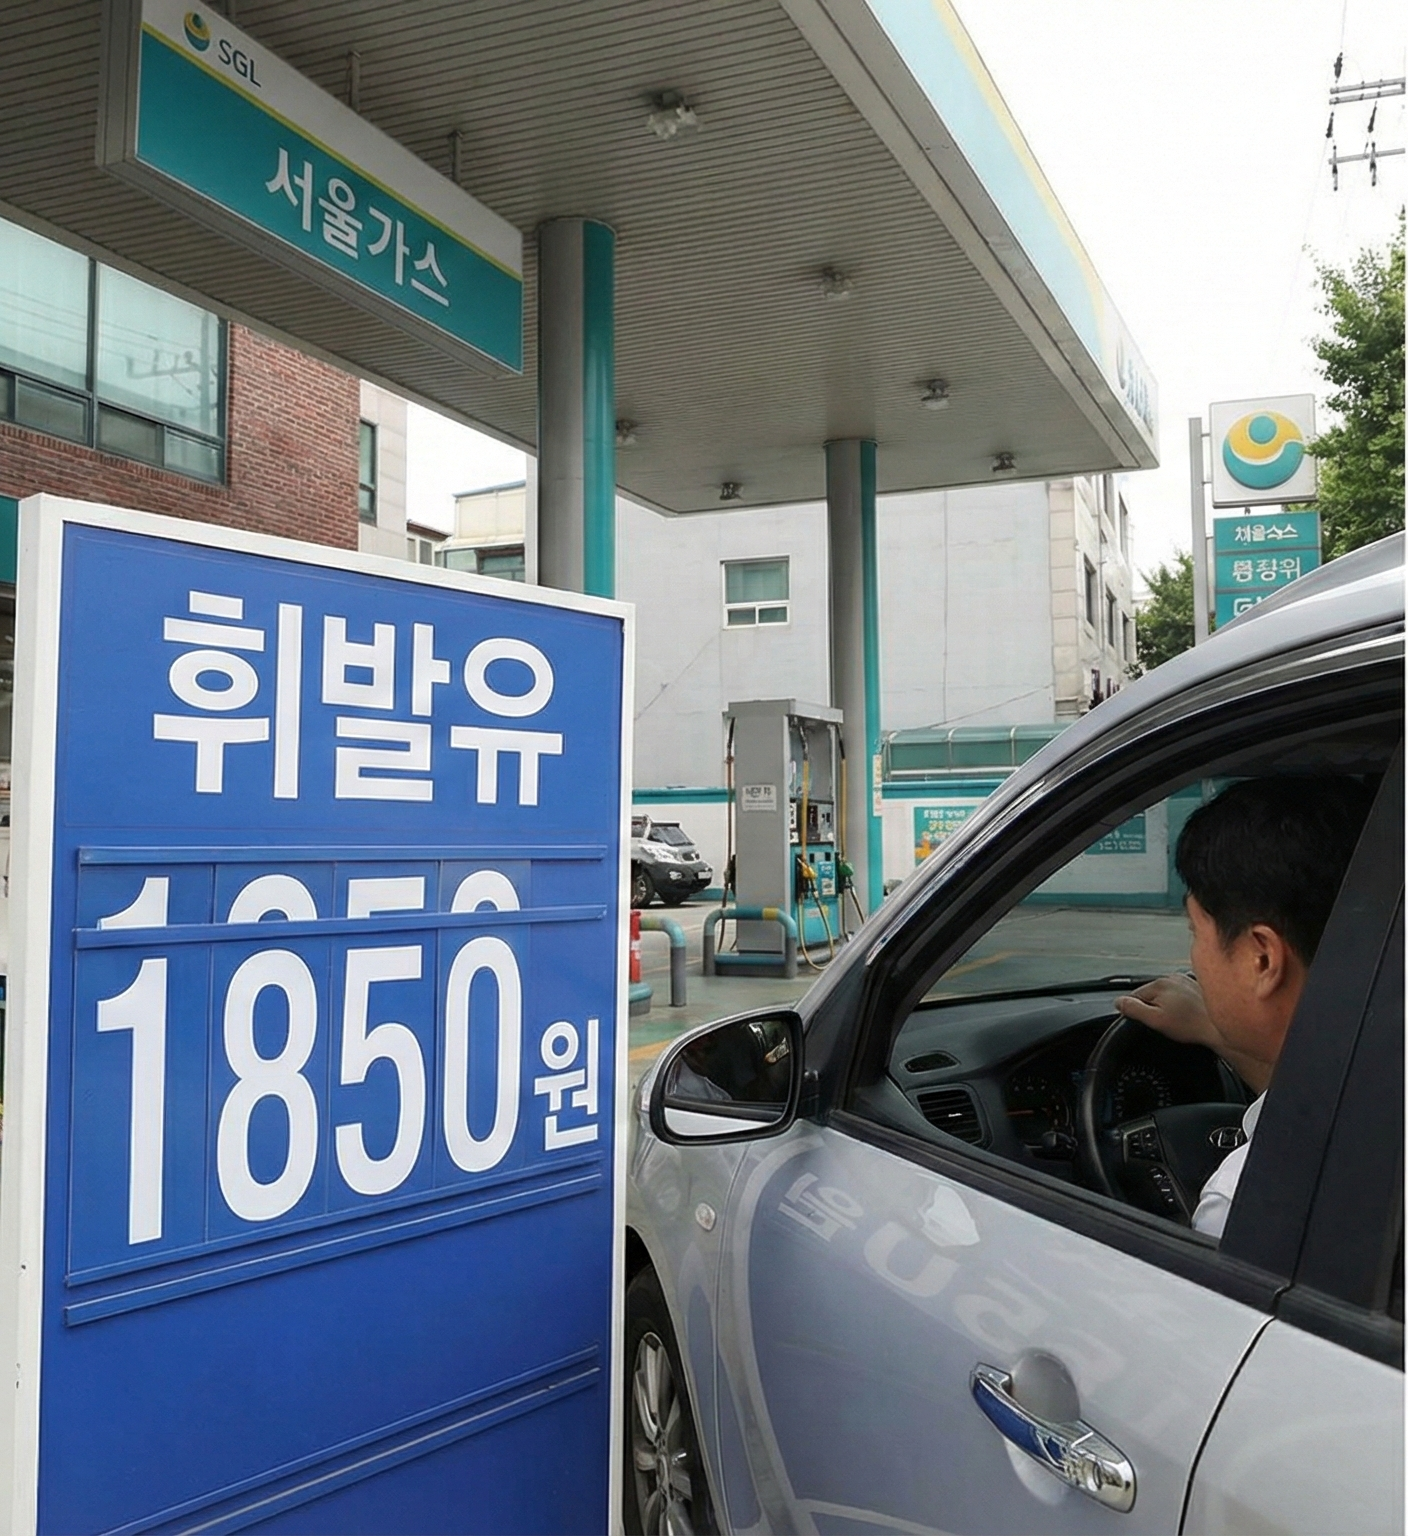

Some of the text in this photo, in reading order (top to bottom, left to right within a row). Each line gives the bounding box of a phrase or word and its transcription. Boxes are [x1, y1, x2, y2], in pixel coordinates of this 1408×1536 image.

[218, 39, 261, 88] SGL
[265, 147, 450, 307] 서울가스
[152, 589, 565, 807] 휘발유
